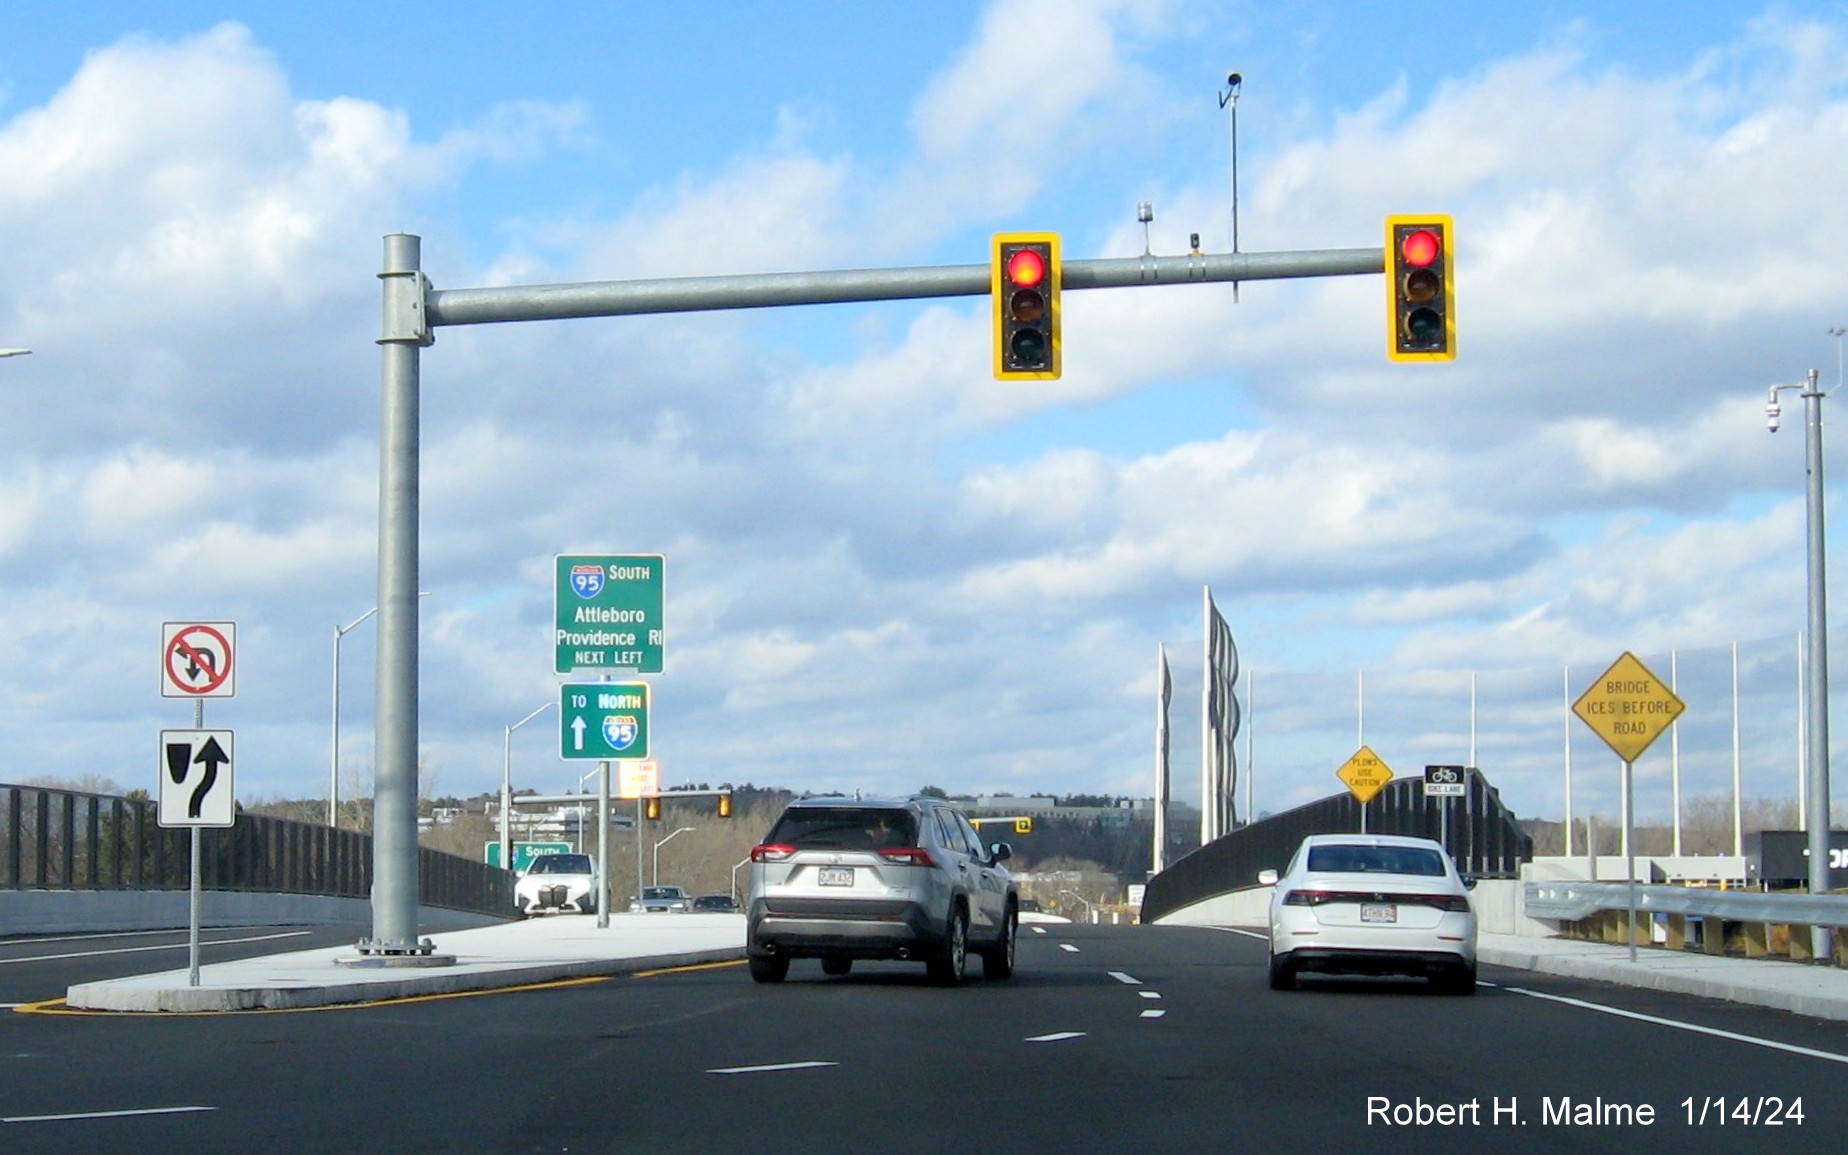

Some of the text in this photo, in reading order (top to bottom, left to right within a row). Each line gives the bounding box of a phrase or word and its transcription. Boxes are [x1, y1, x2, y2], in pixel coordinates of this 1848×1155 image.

[609, 565, 650, 580] SOUTH
[576, 575, 599, 591] 95
[575, 606, 645, 623] Attleboro
[557, 629, 636, 646] Providence
[575, 651, 643, 664] NEXT LEFT
[1606, 681, 1650, 694] BRIDGE
[571, 693, 641, 709] TO NORTH
[1587, 701, 1672, 714] ICES BEFORE
[608, 725, 632, 742] 95
[1614, 721, 1646, 735] ROAD
[1352, 758, 1378, 766] PLOWS
[1358, 769, 1372, 777] USE
[1349, 778, 1381, 787] CAUTION
